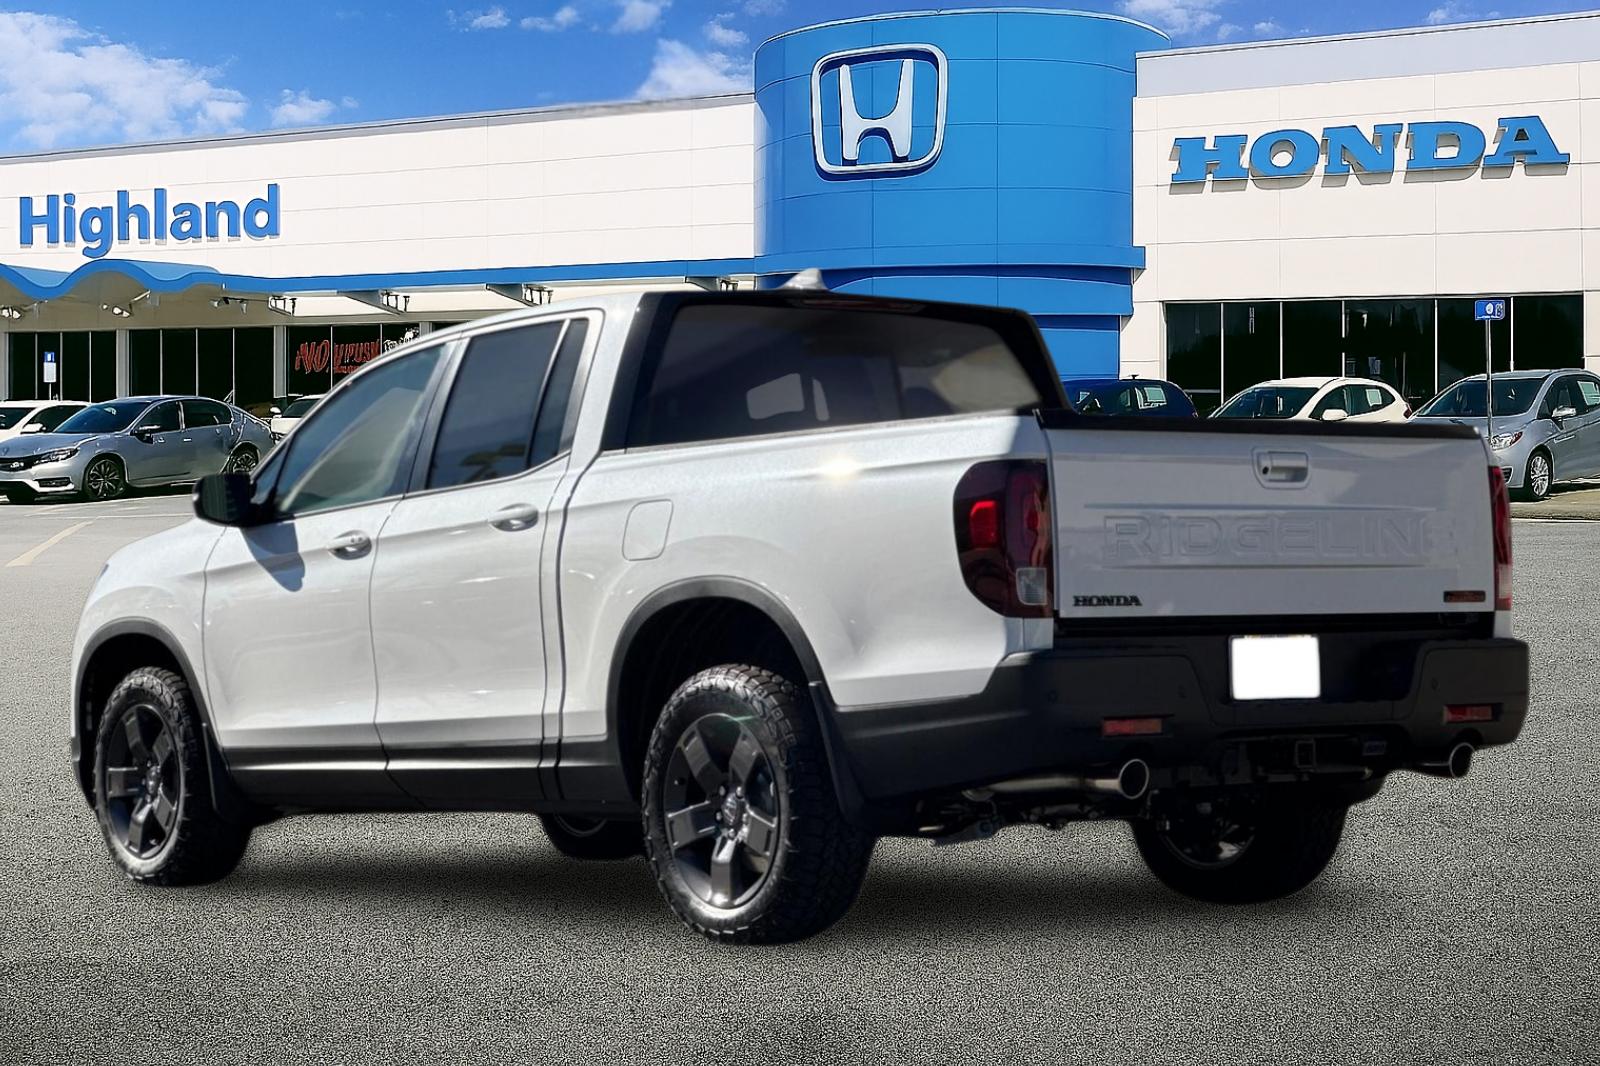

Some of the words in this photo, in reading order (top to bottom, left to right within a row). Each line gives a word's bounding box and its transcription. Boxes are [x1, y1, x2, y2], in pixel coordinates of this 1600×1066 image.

[1169, 115, 1570, 186] HONDA
[19, 183, 281, 258] Highland
[1072, 594, 1143, 608] HONDA
